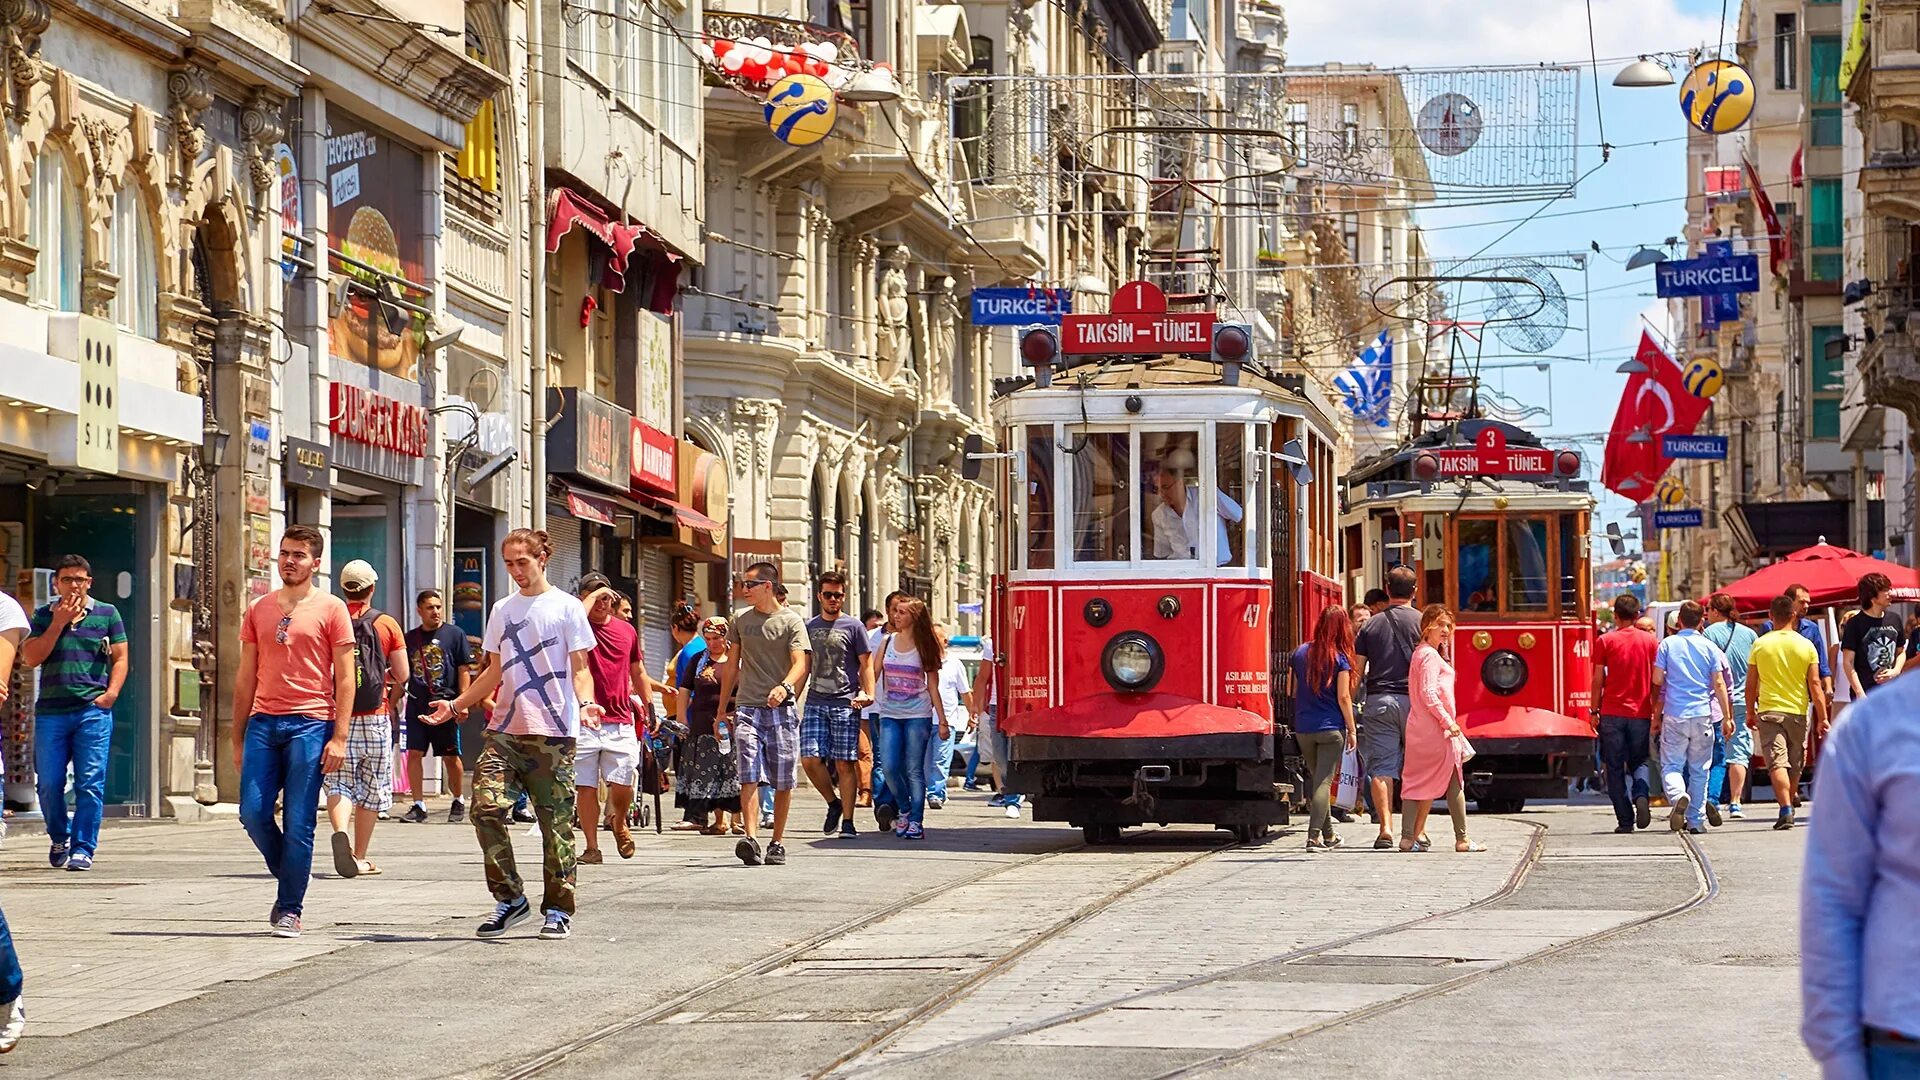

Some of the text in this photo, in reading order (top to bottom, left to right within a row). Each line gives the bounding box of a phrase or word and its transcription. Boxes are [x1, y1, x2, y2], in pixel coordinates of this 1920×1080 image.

[1661, 265, 1753, 288] TURKCELL
[977, 298, 1067, 315] TURKCELL
[1134, 285, 1143, 309] 1
[1076, 319, 1133, 343] TAKSİM
[1152, 319, 1206, 342] TÜNEL
[338, 382, 393, 447] BURGER
[85, 422, 112, 450] SIX
[1486, 431, 1495, 448] 3
[1665, 440, 1725, 453] TURKCELL
[1440, 454, 1479, 471] TAKSİM
[1506, 454, 1546, 471] TÜNEL
[1656, 514, 1700, 525] TURKCELL
[1013, 605, 1026, 630] 47
[1243, 603, 1260, 628] 47
[1225, 684, 1235, 694] VE
